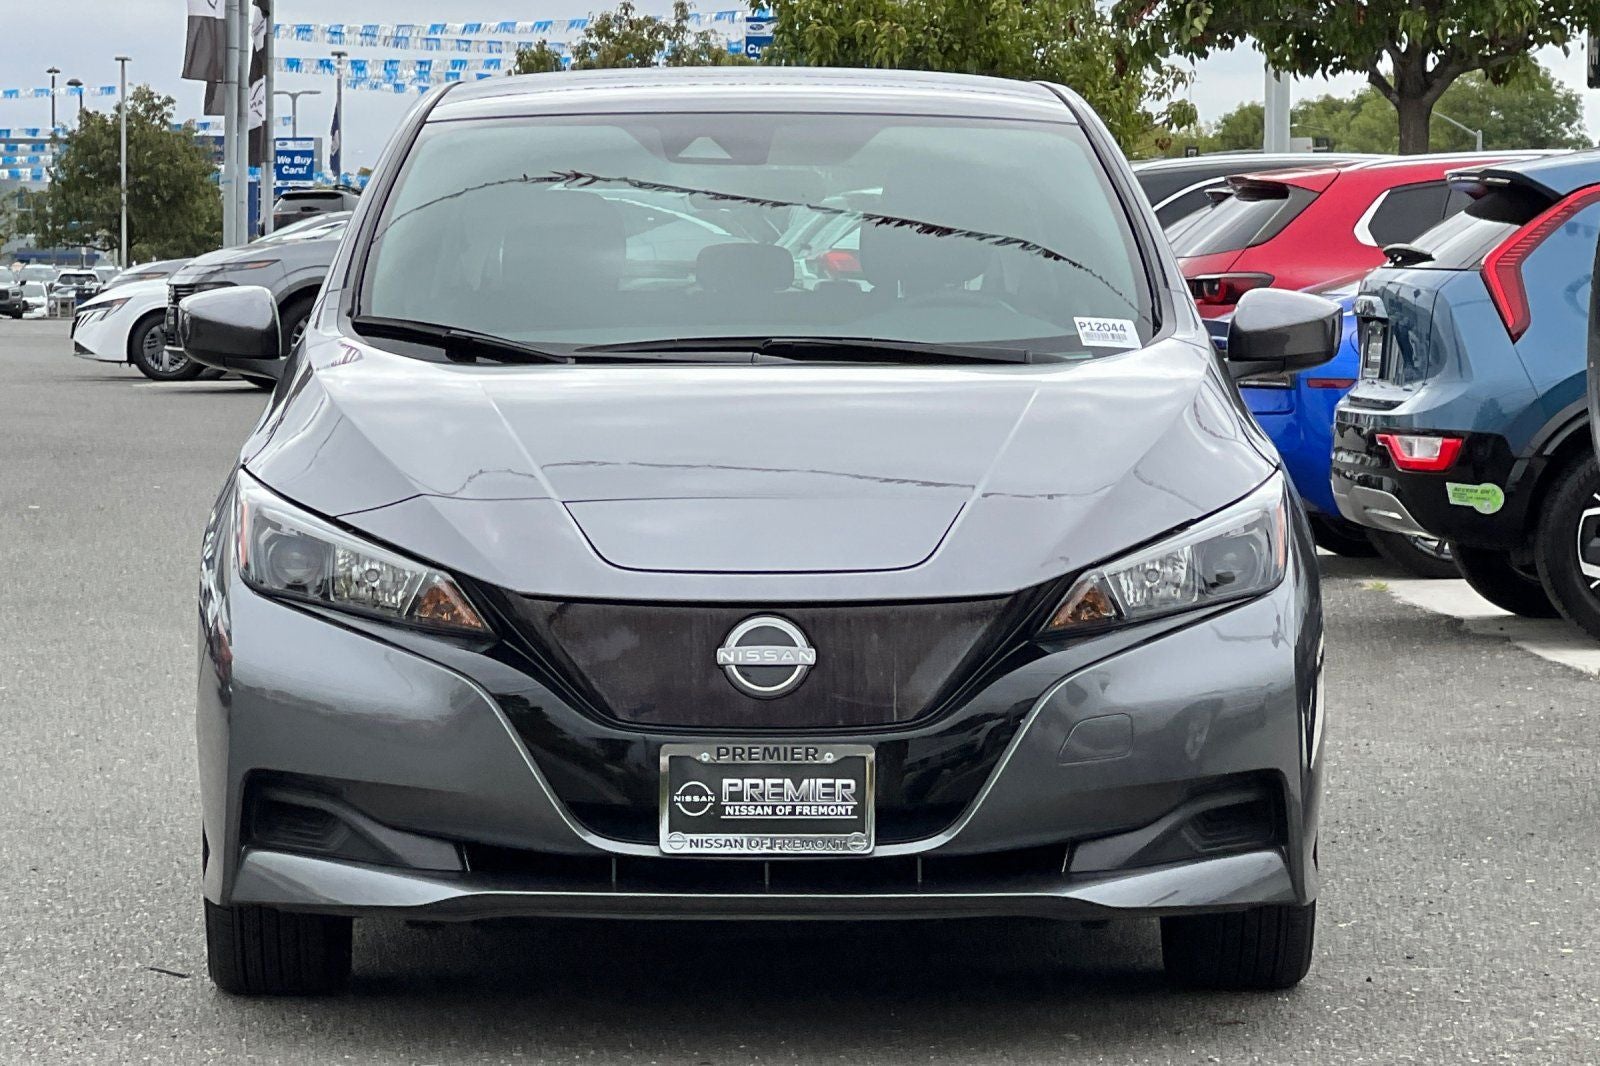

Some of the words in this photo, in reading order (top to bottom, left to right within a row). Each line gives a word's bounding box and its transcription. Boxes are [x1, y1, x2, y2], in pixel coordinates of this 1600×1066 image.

[277, 155, 291, 164] We
[294, 155, 312, 166] Buy
[282, 165, 307, 174] Cars!
[1078, 321, 1127, 333] P12044
[719, 649, 814, 663] NISSAN
[715, 746, 820, 762] PREMIER
[721, 778, 857, 803] PREMIER
[673, 795, 716, 803] NISSAN
[724, 805, 774, 816] NISSAN
[775, 805, 793, 816] OF
[795, 805, 854, 816] FREMONT
[689, 838, 744, 849] NISSAN
[746, 838, 770, 850] OF
[772, 838, 847, 851] FREMONT
